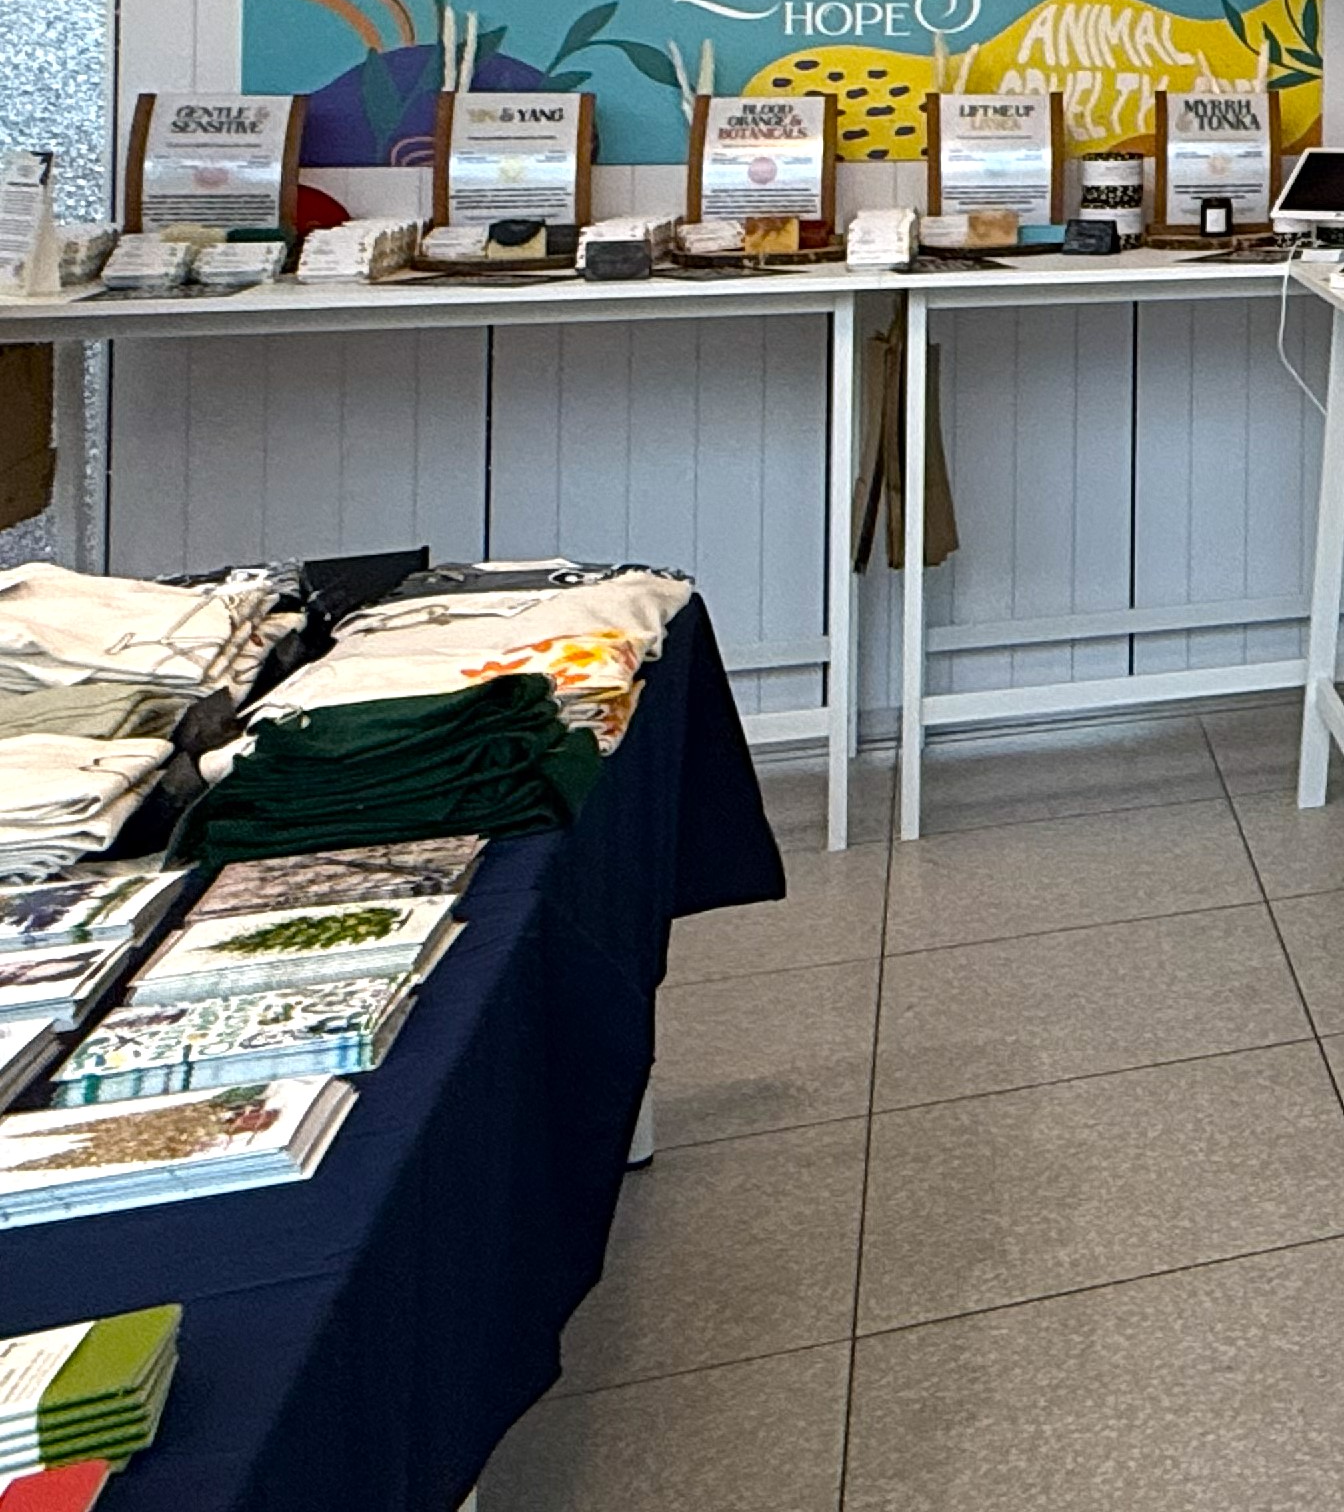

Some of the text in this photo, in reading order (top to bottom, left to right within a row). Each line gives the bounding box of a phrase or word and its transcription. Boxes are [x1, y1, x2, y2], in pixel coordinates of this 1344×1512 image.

[783, 0, 912, 37] HOPE
[1017, 3, 1196, 69] ANIMAL
[175, 105, 245, 121] GENTLE
[517, 107, 565, 123] YANG
[742, 104, 793, 116] BLOOD
[1184, 99, 1252, 117] MYRRH
[170, 119, 264, 135] SENSITIVE
[1197, 114, 1262, 132] TONKA
[718, 126, 809, 139] BOTANICALS
